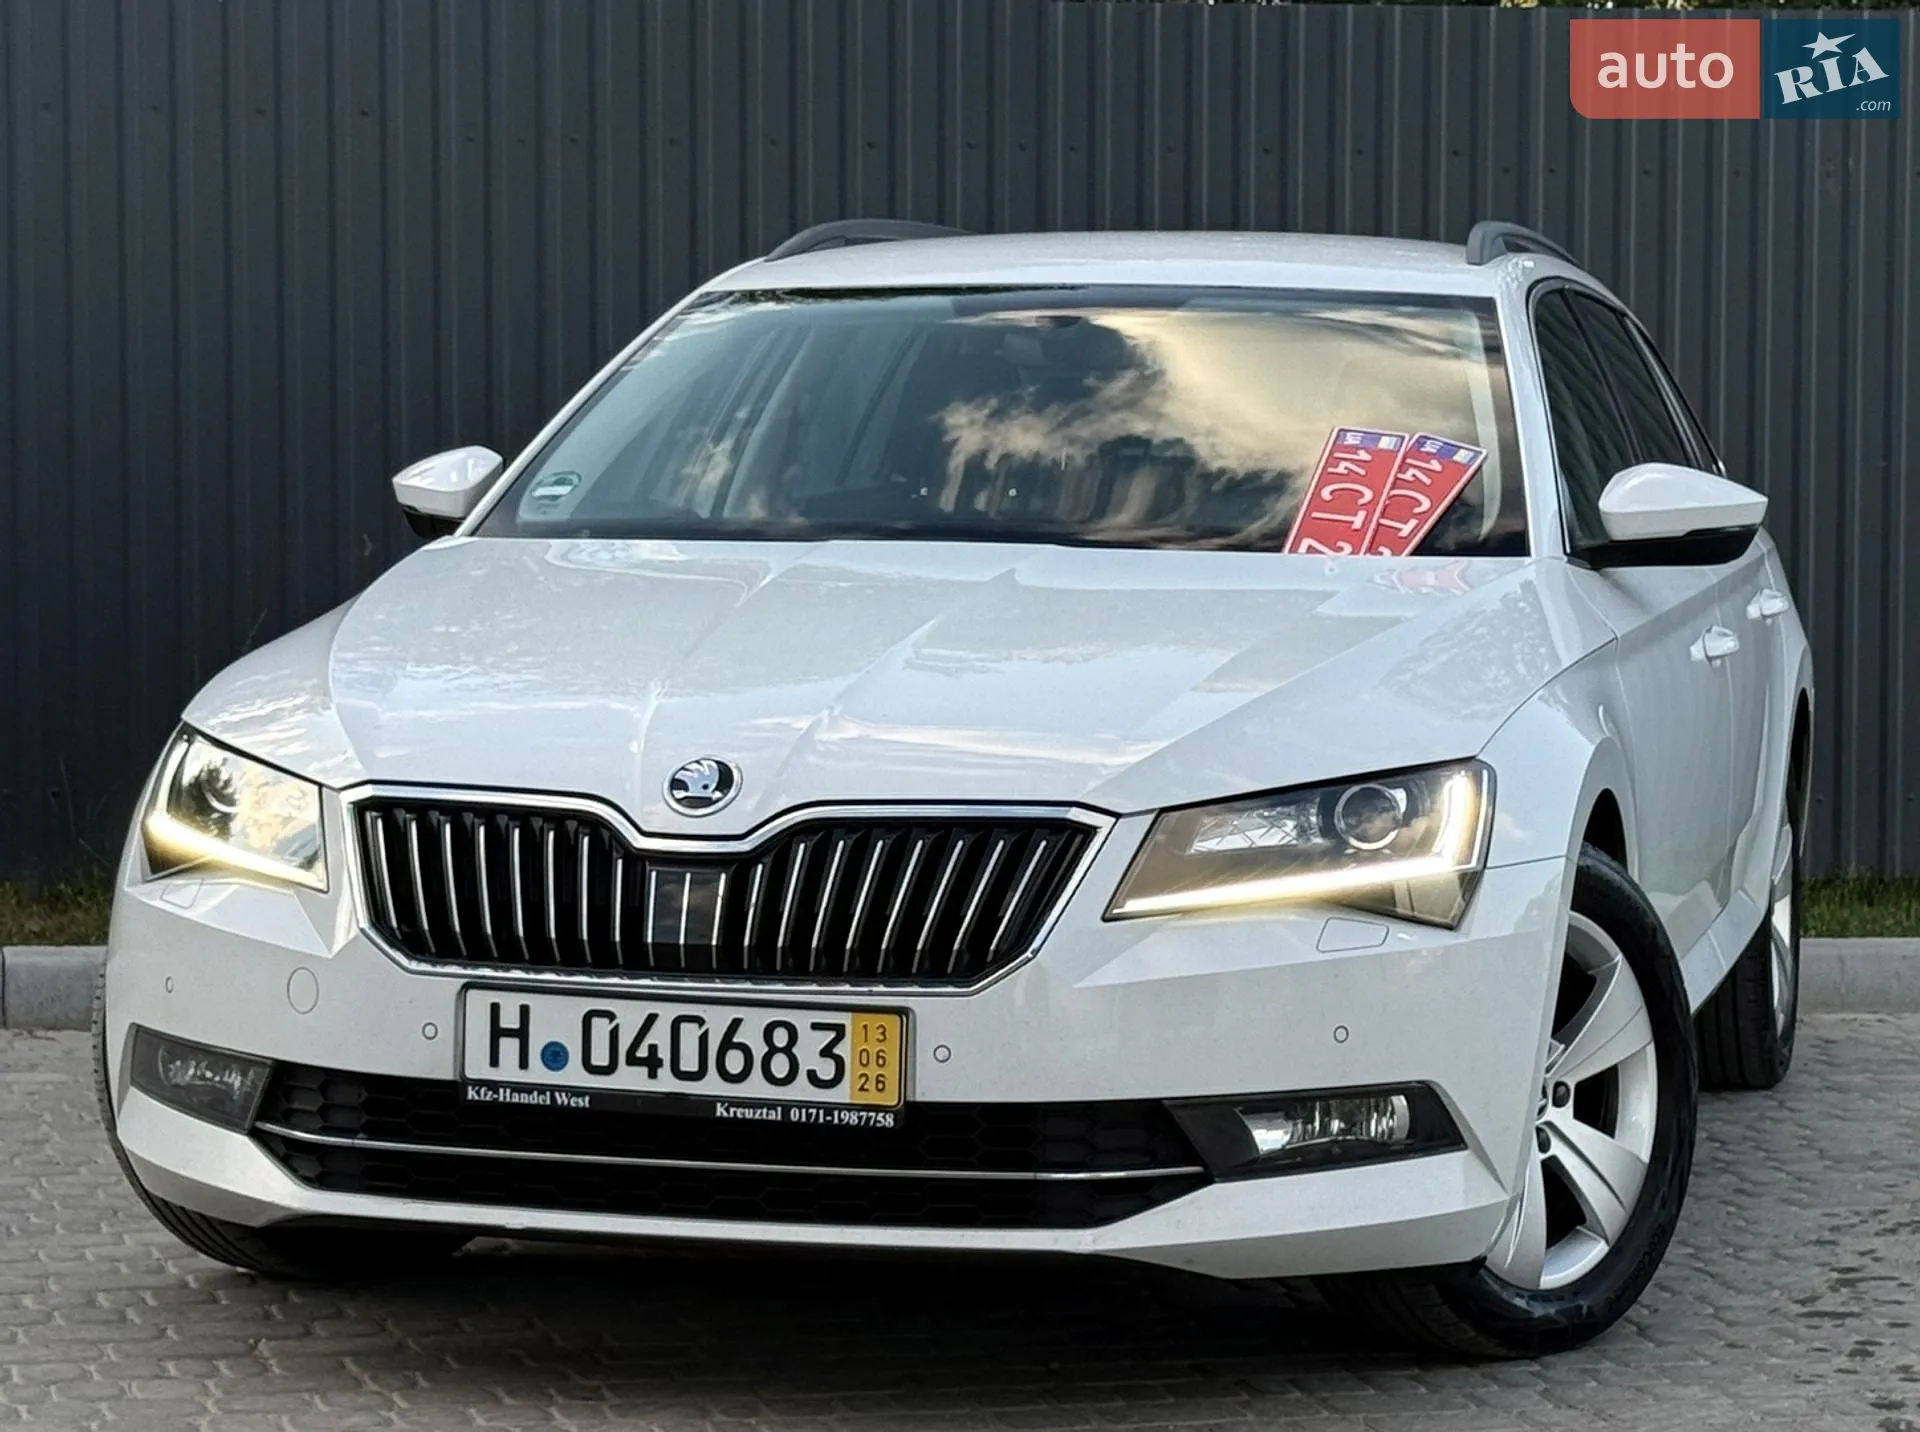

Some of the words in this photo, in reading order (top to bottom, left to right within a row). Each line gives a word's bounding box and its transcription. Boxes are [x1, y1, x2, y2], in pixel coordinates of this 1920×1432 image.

[862, 1023, 887, 1044] 13
[489, 1001, 530, 1071] H
[581, 1008, 847, 1090] 040683
[858, 1047, 887, 1069] 06
[857, 1072, 887, 1093] 26
[466, 1084, 551, 1106] Kfz-Handel
[553, 1091, 591, 1109] West
[714, 1102, 782, 1122] Kreuztal
[789, 1107, 895, 1129] 0171-1987758
